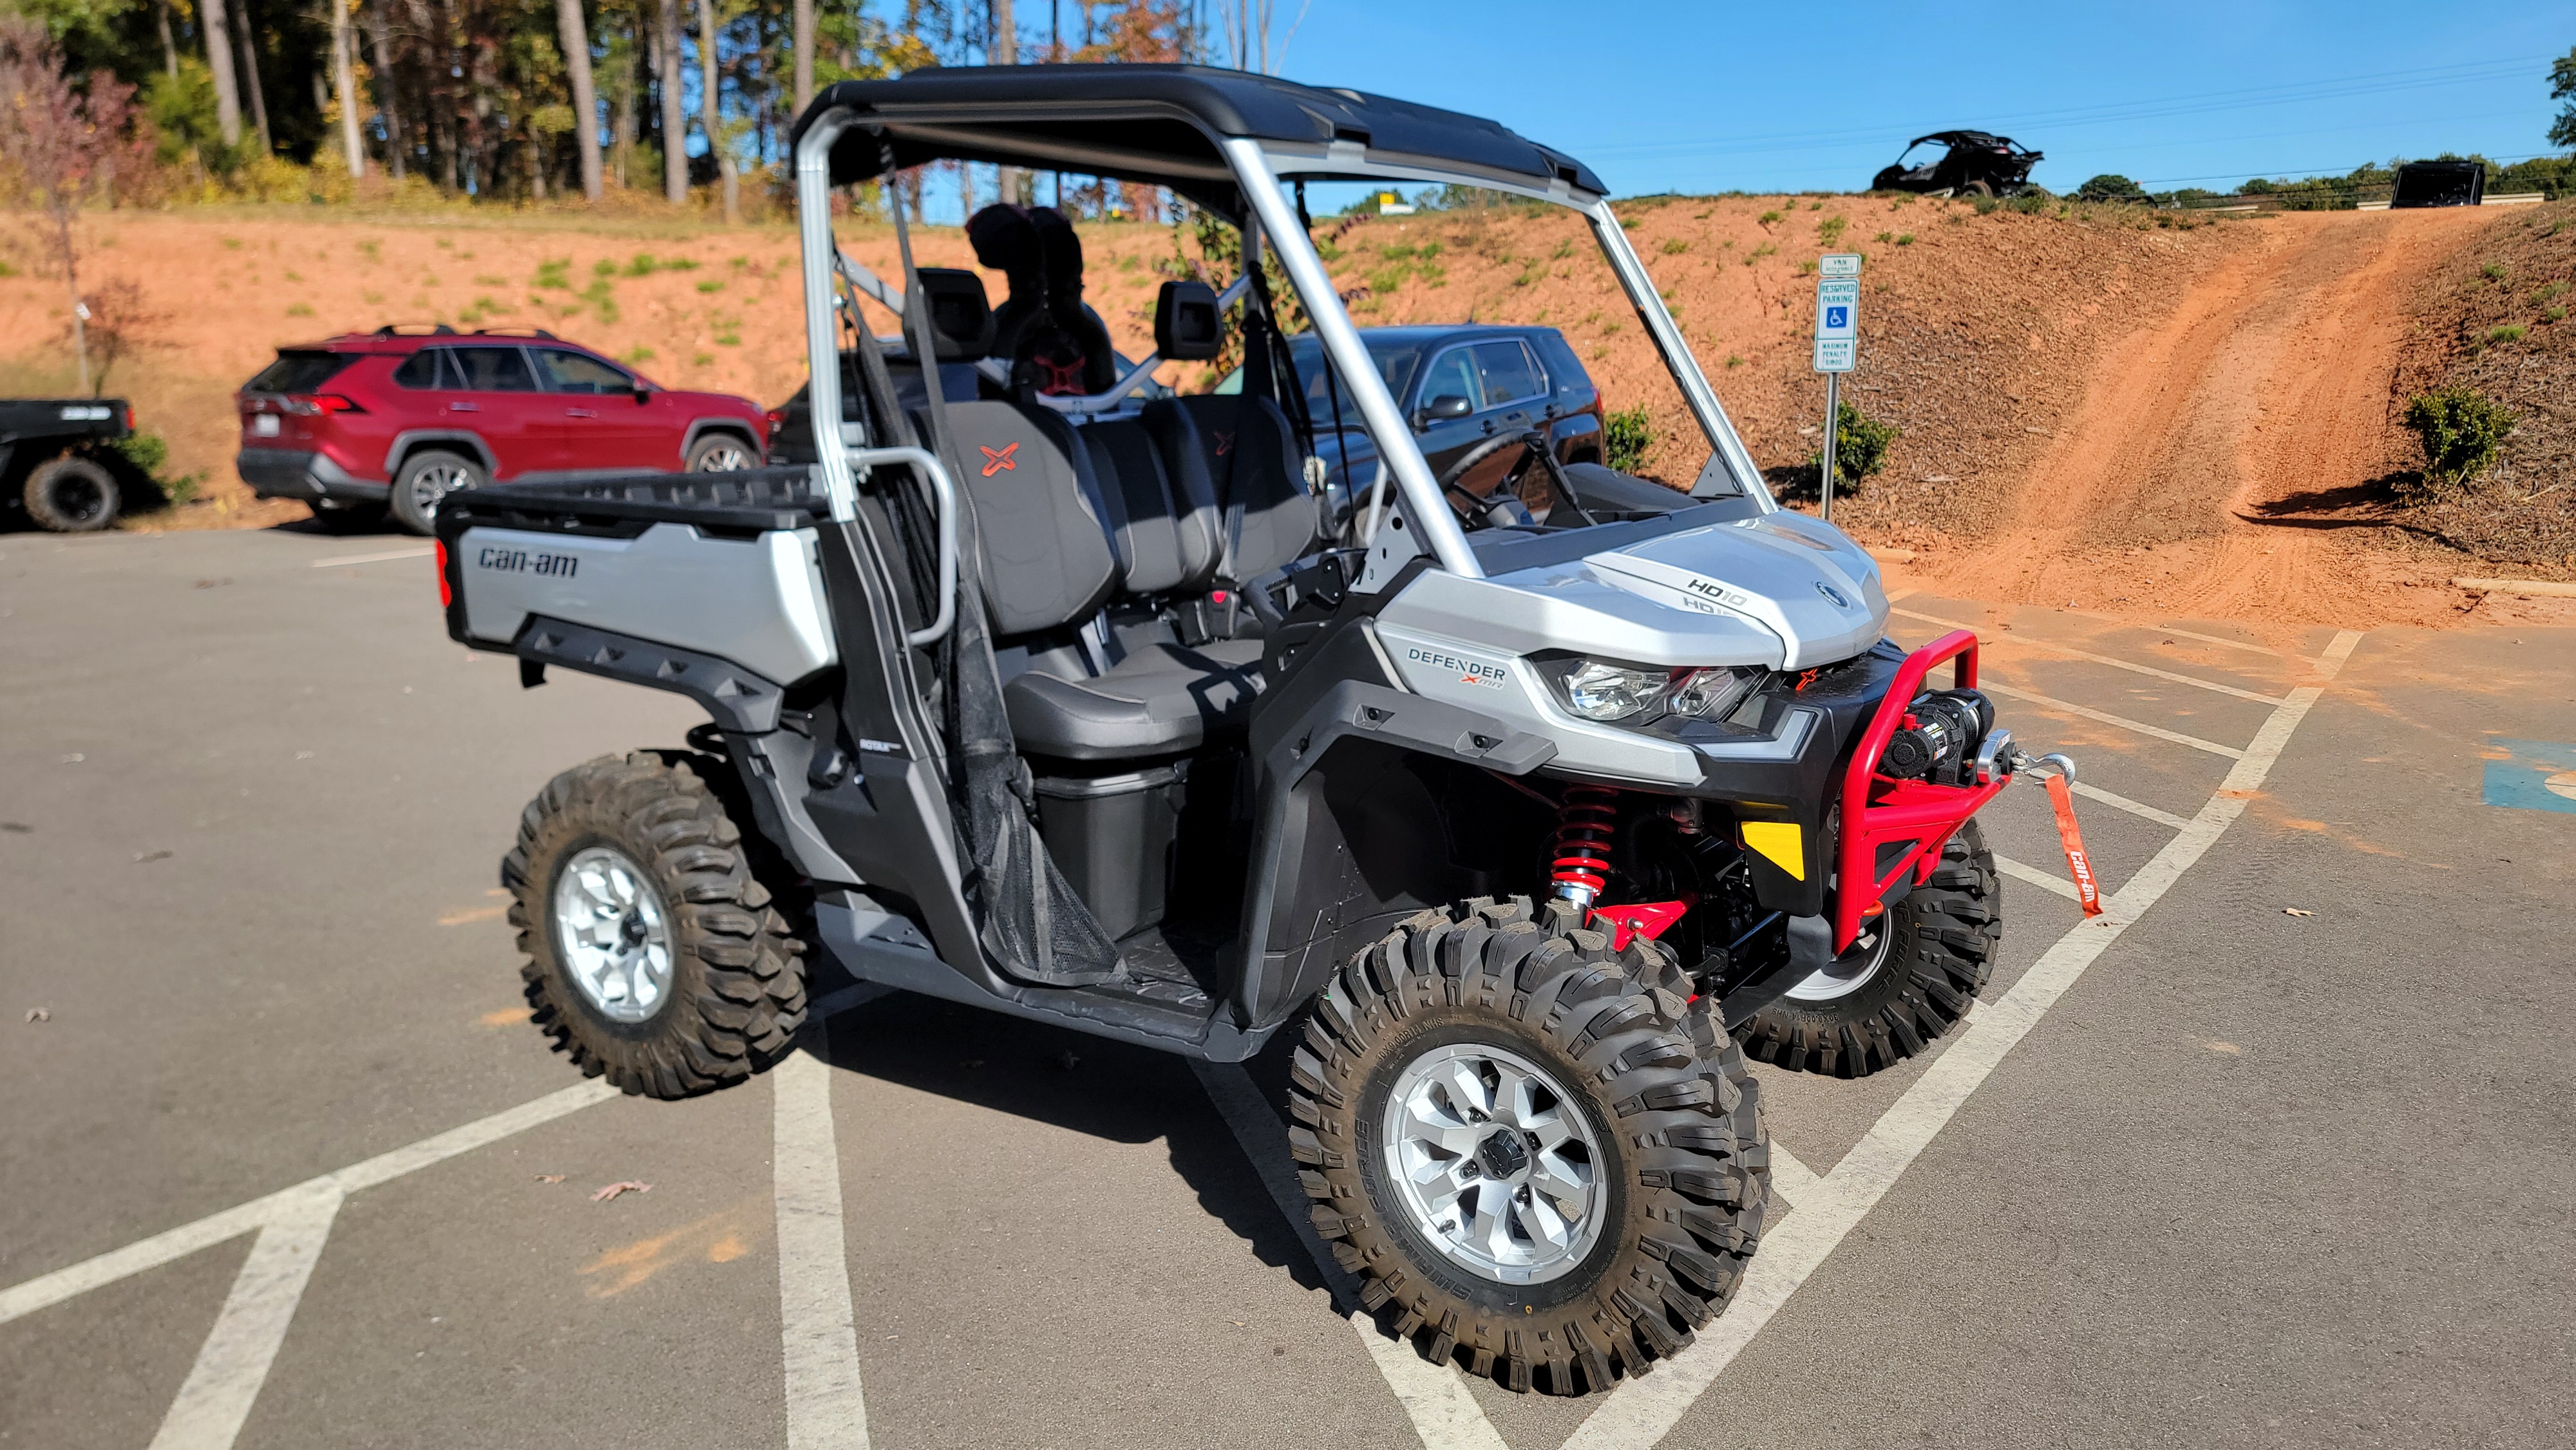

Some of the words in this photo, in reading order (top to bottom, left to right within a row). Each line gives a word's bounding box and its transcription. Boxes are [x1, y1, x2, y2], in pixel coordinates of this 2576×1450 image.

[1821, 283, 1855, 293] RESERVED
[1823, 294, 1853, 303] PARKING
[479, 547, 578, 578] can-am
[1687, 579, 1747, 606] HD10
[1408, 648, 1506, 681] DEFENDER
[2070, 851, 2095, 903] can-am
[1423, 1017, 1444, 1031] NHS
[1771, 1008, 1790, 1019] NHS
[1355, 1118, 1388, 1213] FORCE
